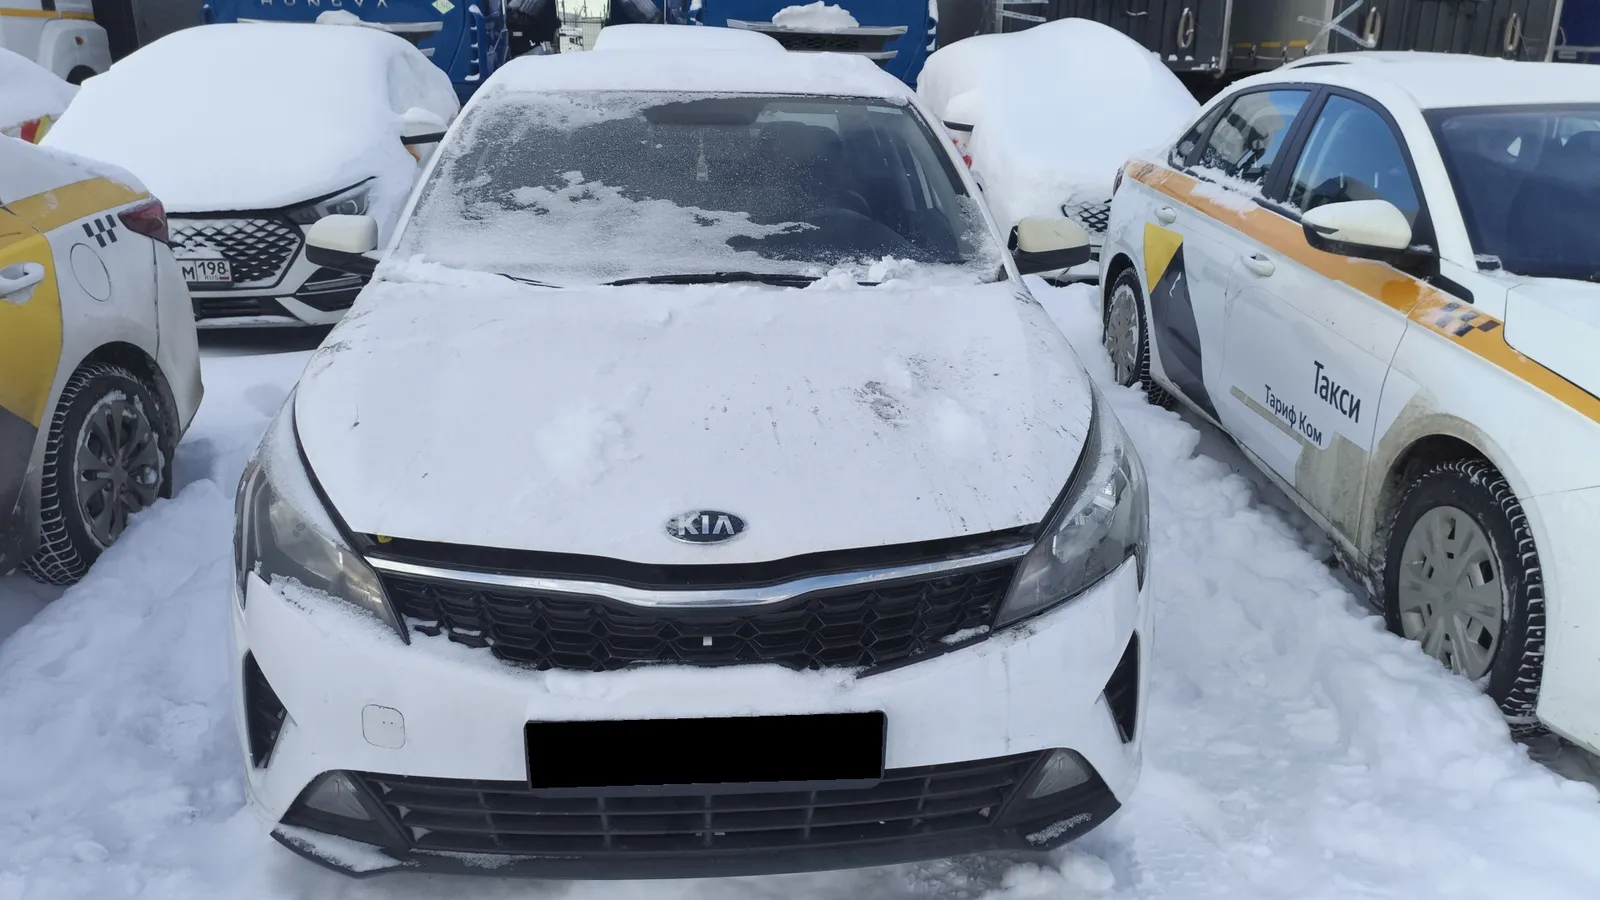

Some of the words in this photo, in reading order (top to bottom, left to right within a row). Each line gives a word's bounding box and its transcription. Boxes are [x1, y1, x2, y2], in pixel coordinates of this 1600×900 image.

[197, 261, 226, 275] 198
[1314, 360, 1361, 424] Такси
[1264, 384, 1297, 428] Тариф
[1299, 411, 1322, 446] Ком
[677, 514, 735, 536] KIA
